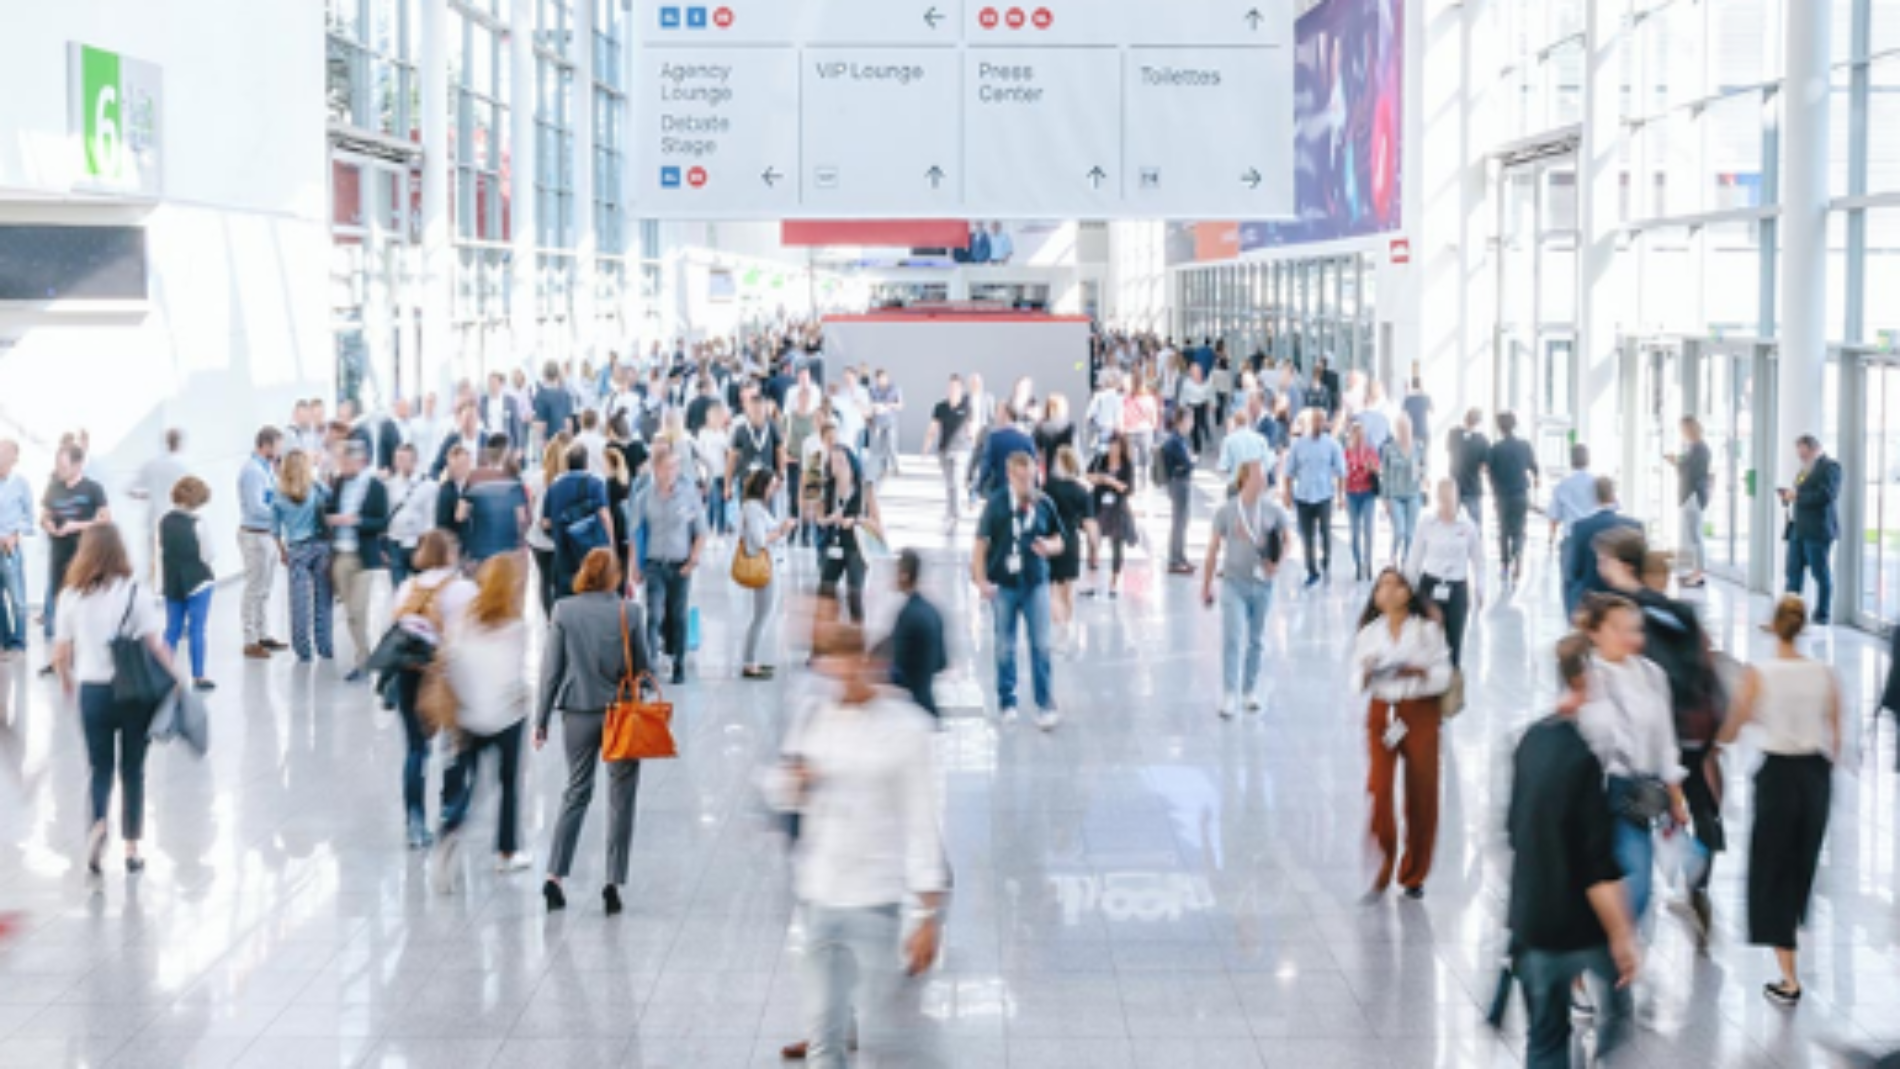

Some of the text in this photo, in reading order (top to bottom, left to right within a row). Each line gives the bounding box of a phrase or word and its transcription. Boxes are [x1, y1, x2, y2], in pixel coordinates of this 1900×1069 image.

[661, 62, 731, 83] Agency
[816, 62, 924, 84] VIP Lounge
[979, 62, 1033, 81] Press
[1141, 66, 1221, 86] Toilettes
[661, 86, 731, 106] Lounge
[979, 84, 1044, 103] Center
[96, 83, 120, 178] 6
[661, 114, 729, 132] Debate
[661, 136, 716, 156] Stage
